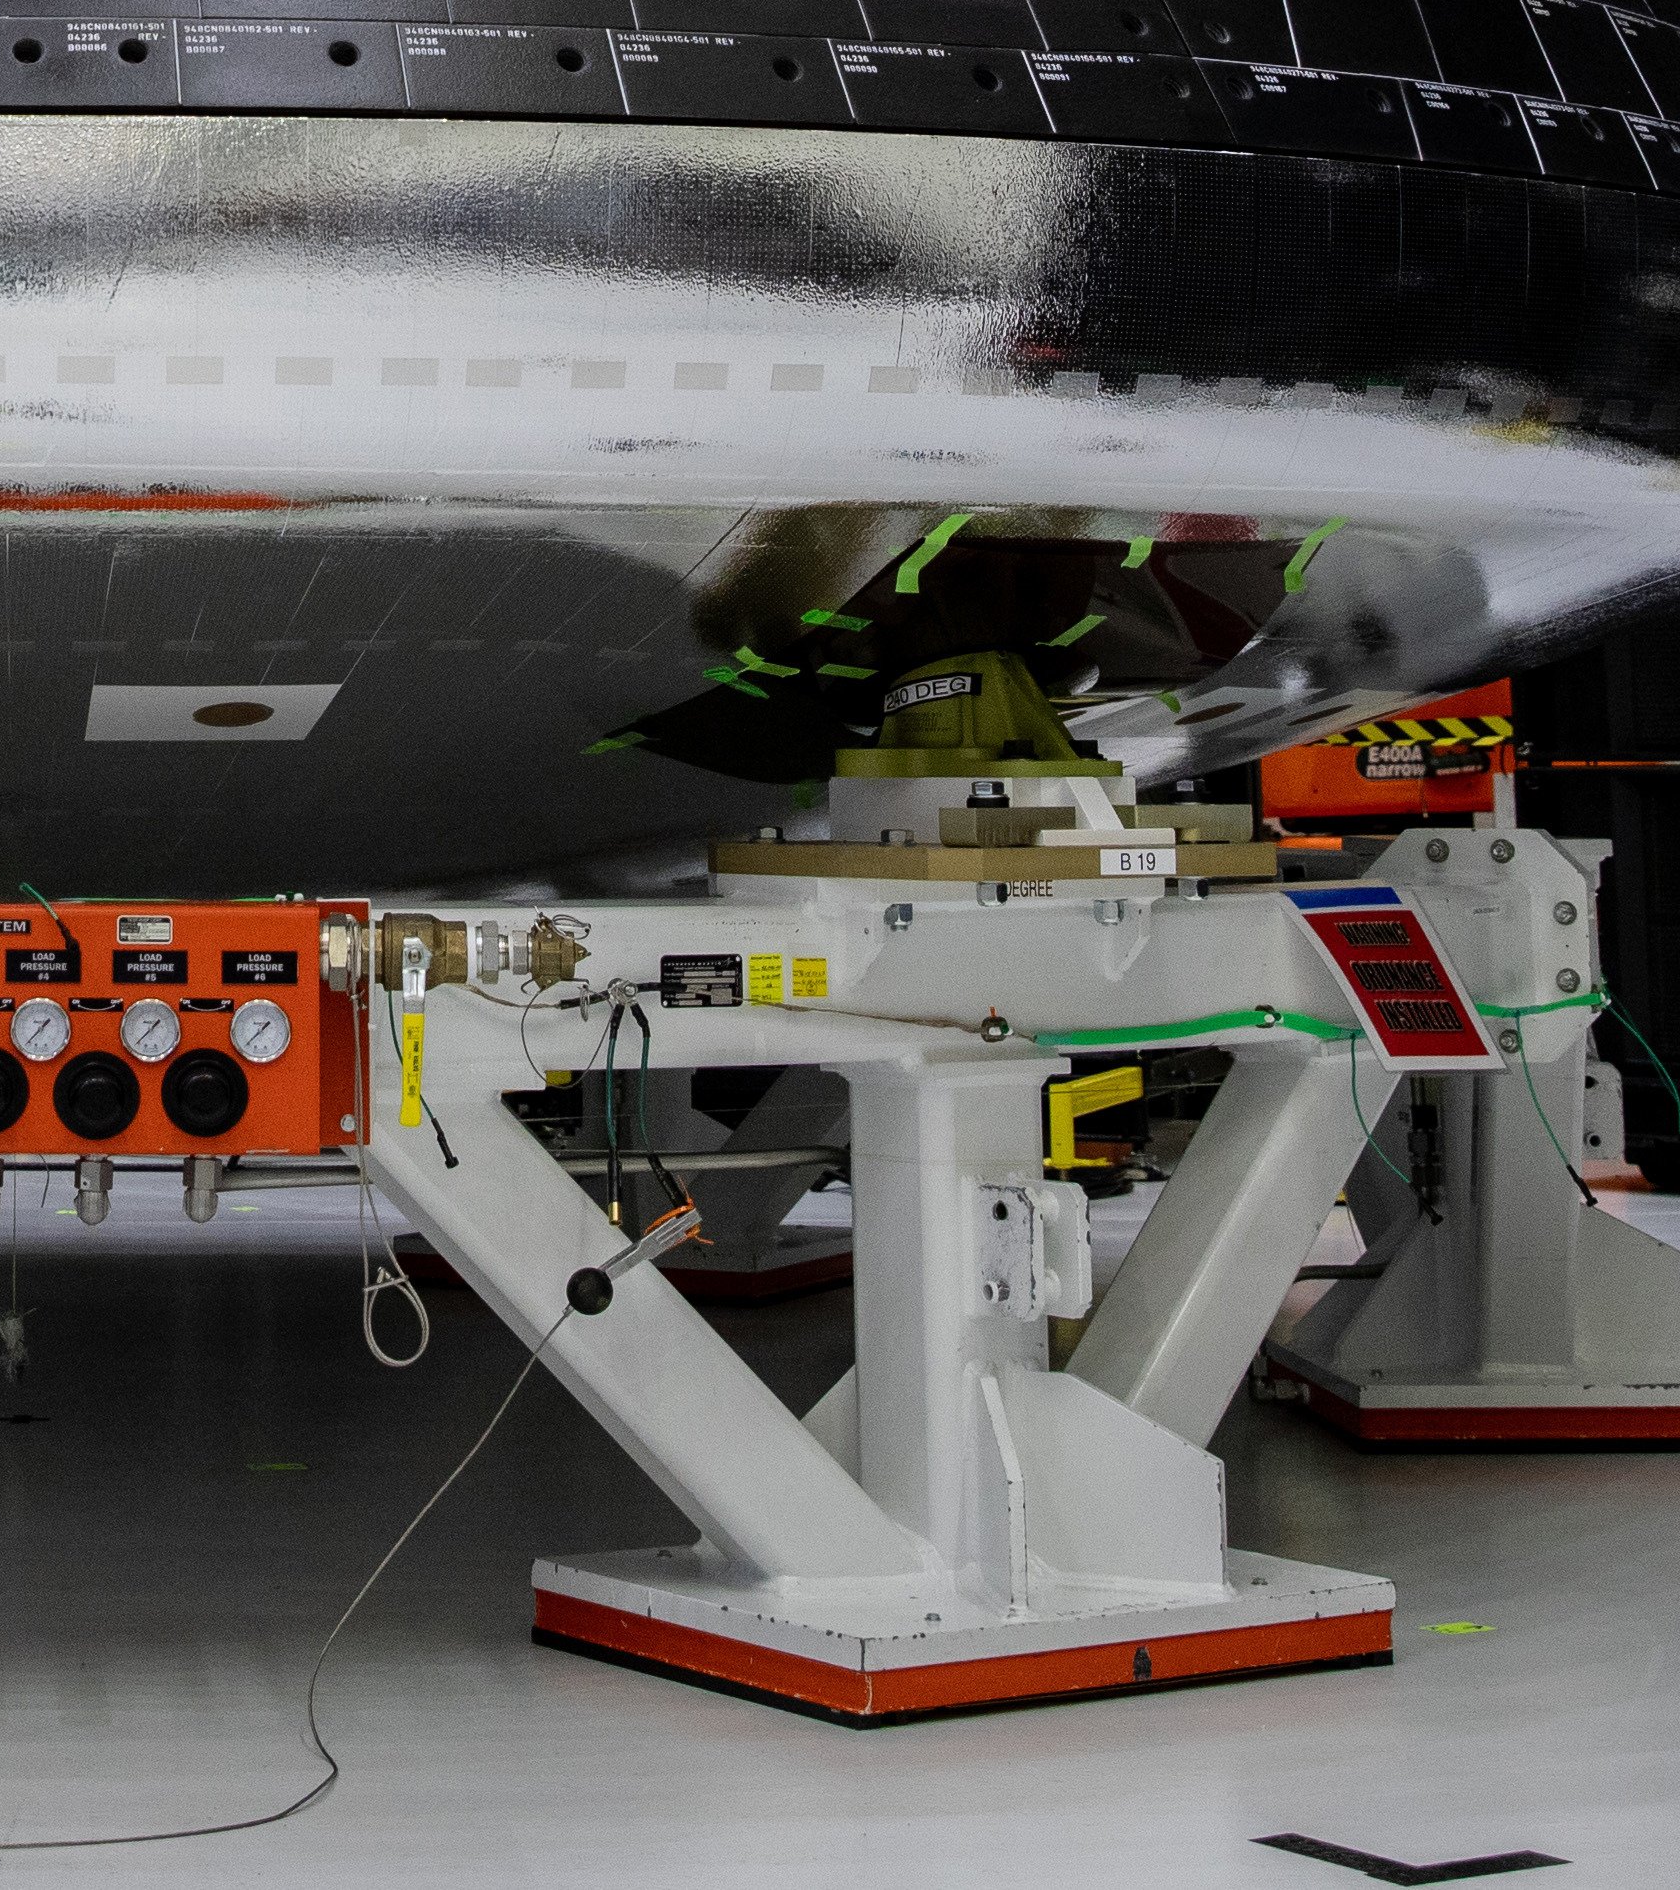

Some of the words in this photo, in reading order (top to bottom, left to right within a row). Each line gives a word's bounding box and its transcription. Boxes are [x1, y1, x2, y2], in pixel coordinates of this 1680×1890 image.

[289, 26, 310, 34] REV
[138, 33, 159, 41] REV
[886, 688, 909, 710] 240
[915, 676, 967, 699] DEG
[1367, 745, 1423, 763] E400A
[1366, 763, 1426, 778] narrow
[1120, 852, 1131, 871] B
[1137, 852, 1156, 871] 19
[32, 953, 56, 961] LOAD
[139, 953, 163, 962] LOAD
[248, 953, 272, 962] LOAD
[20, 963, 67, 971] PRESSURE
[127, 963, 175, 972] PRESSURE
[236, 963, 284, 972] PRESSURE
[38, 972, 50, 981] #4
[145, 973, 157, 982] #5
[254, 974, 266, 982] #6
[1373, 998, 1464, 1032] INSTALLED
